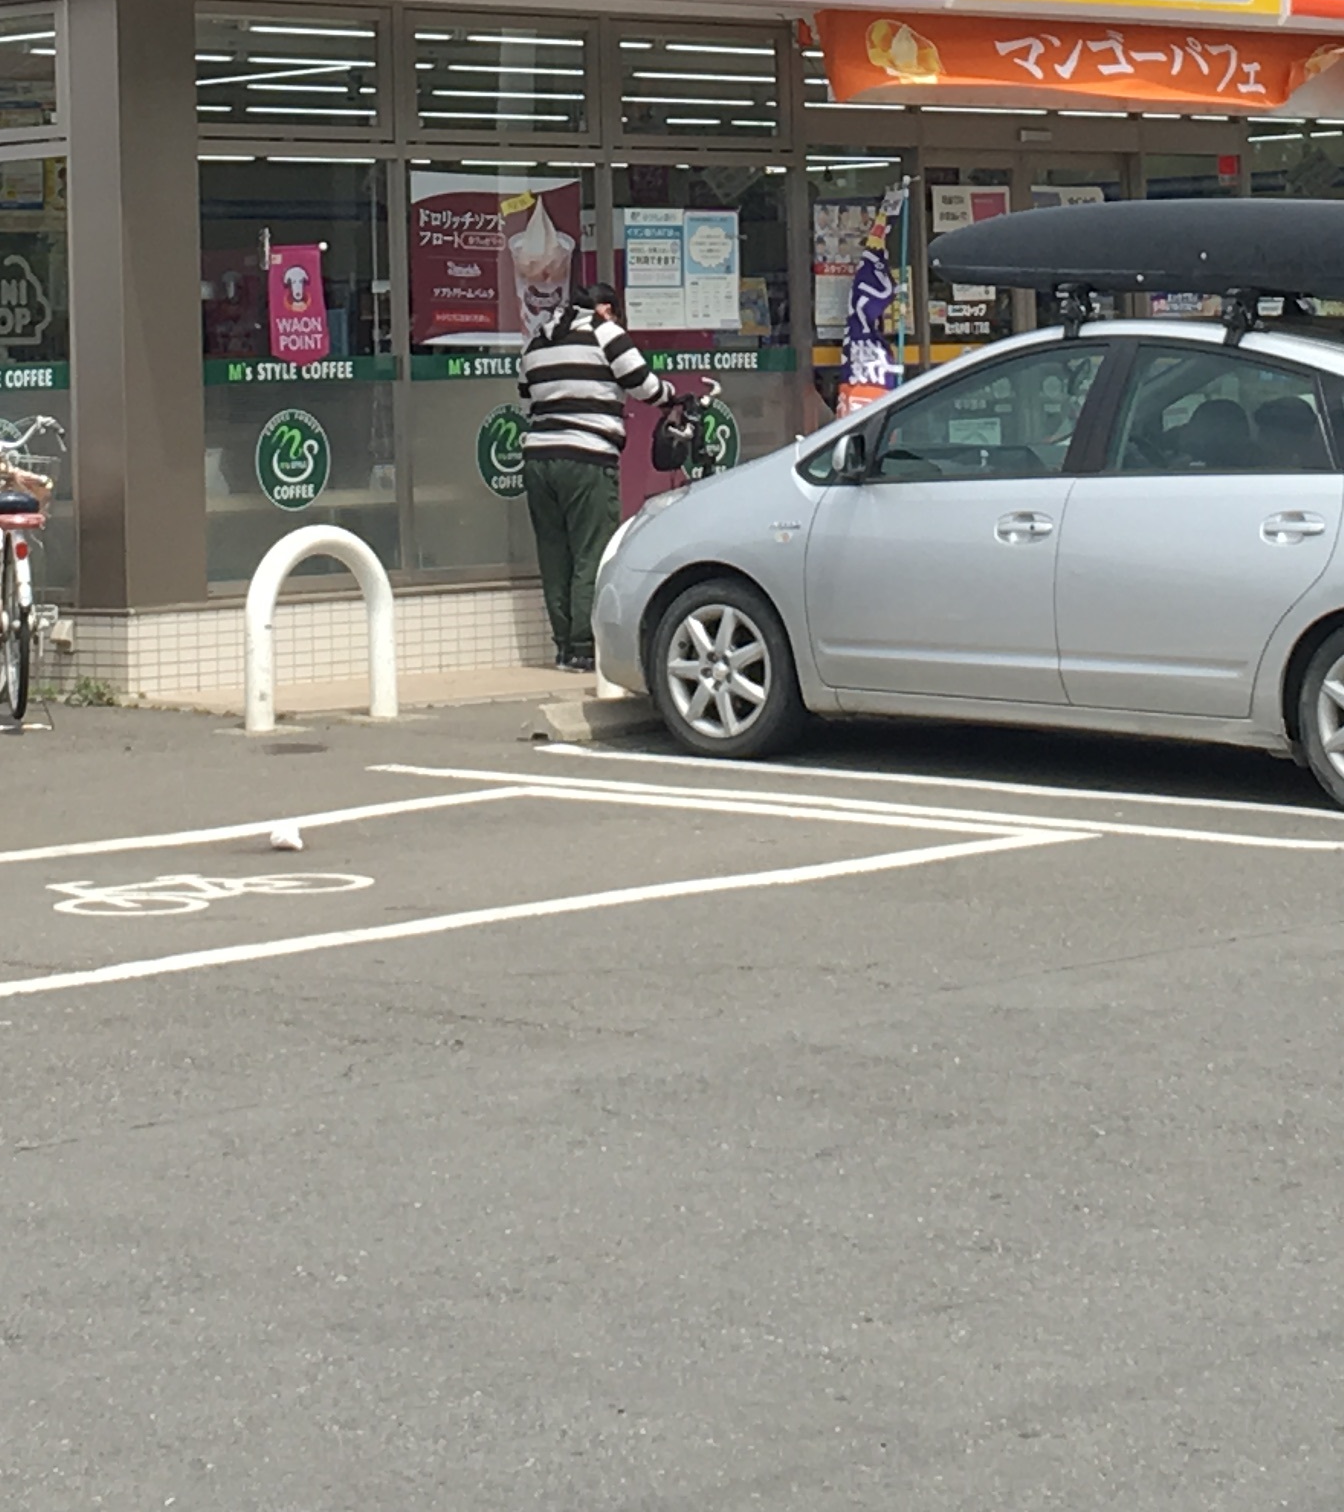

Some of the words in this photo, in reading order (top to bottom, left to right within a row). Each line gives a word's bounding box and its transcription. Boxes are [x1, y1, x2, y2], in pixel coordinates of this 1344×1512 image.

[994, 29, 1266, 94] マンゴーパフェ
[419, 208, 505, 231] ドロリッチソフト
[419, 231, 461, 248] フロート
[276, 316, 322, 334] WAON
[279, 334, 324, 351] POINT
[448, 358, 471, 375] M's
[474, 357, 513, 375] STYLE
[652, 353, 673, 371] M's
[676, 353, 711, 370] STYLE
[714, 352, 758, 369] COFFEE
[5, 368, 53, 388] COFFEE
[228, 362, 253, 382] M's
[257, 362, 298, 381] STYLE
[301, 361, 354, 380] COFFEE
[490, 474, 524, 490] COFFE
[273, 483, 315, 500] COFFEE
